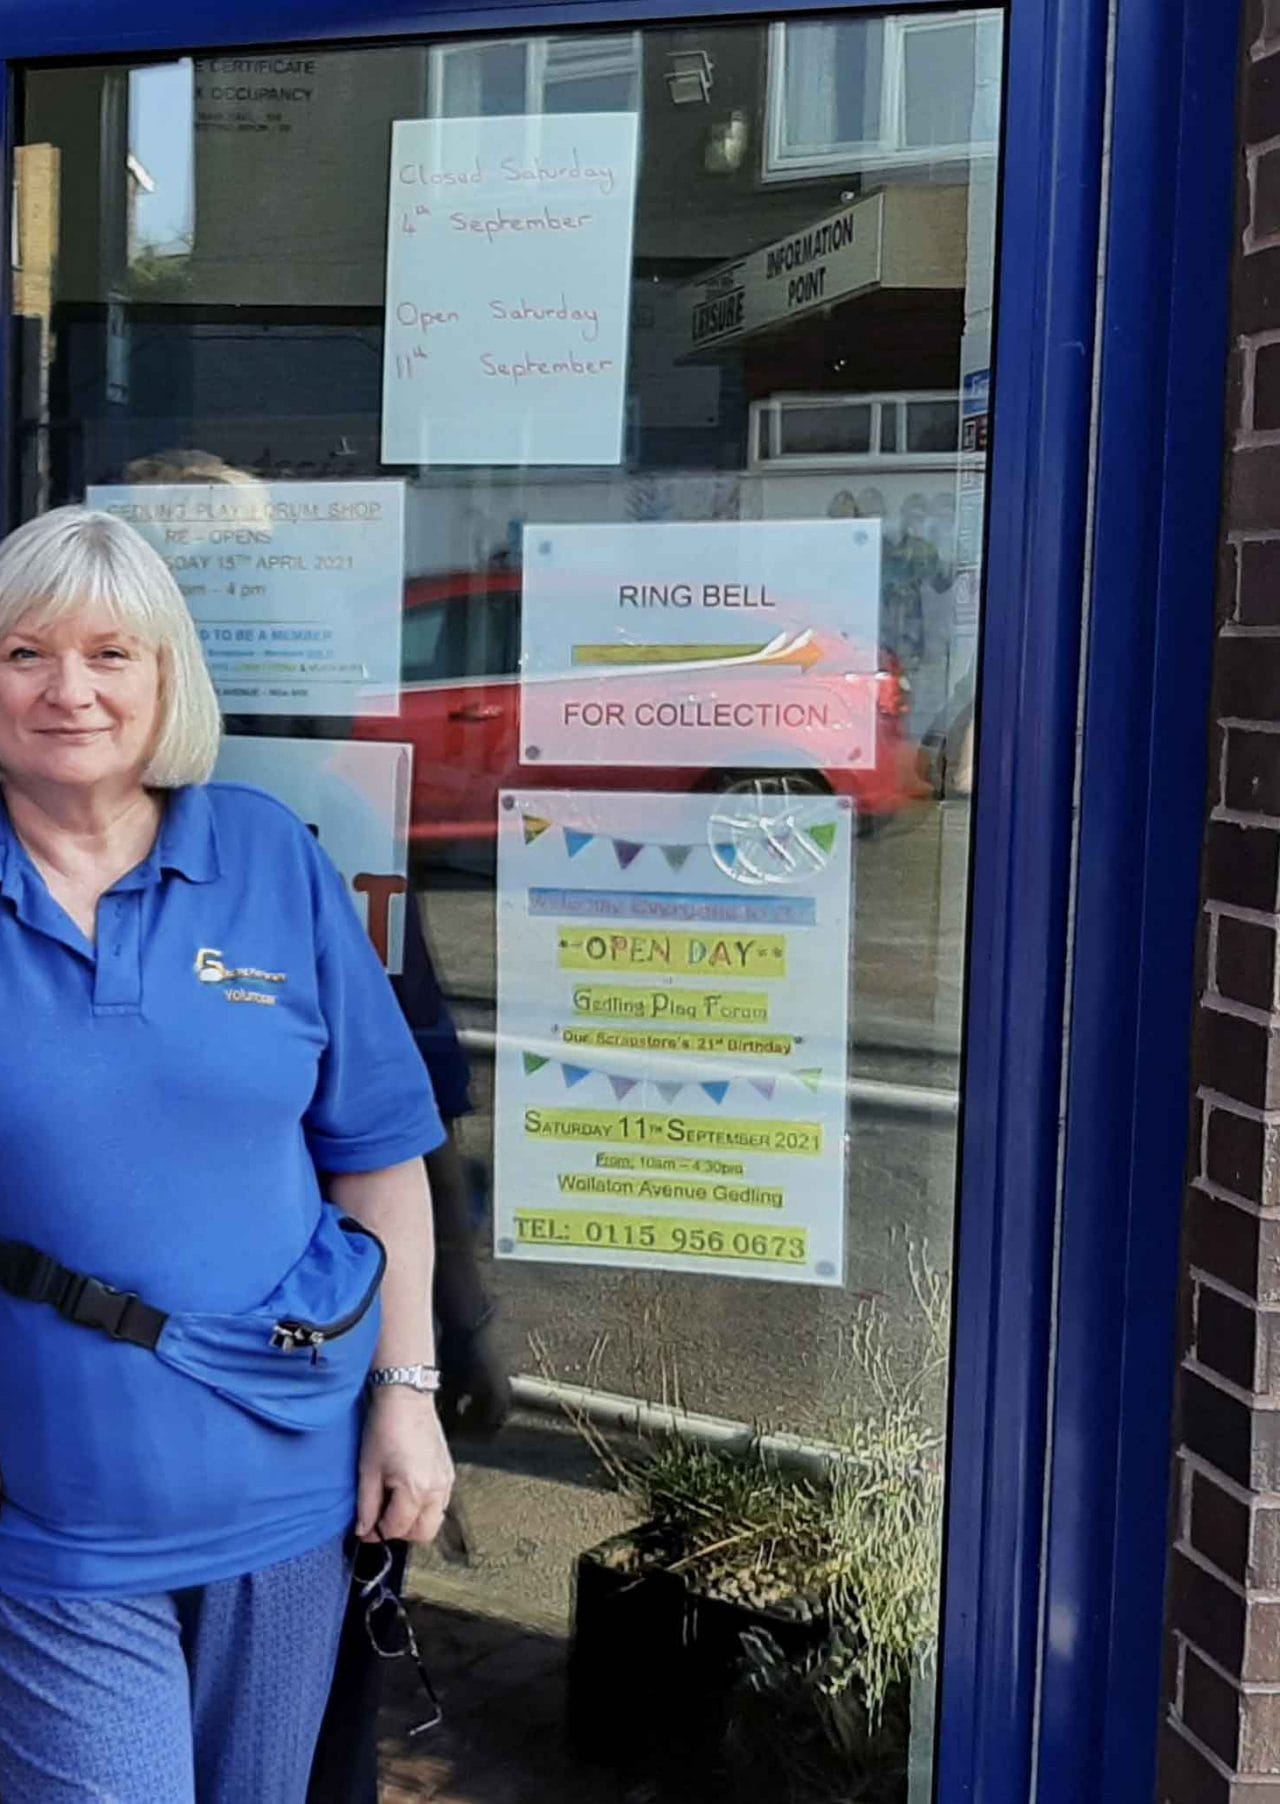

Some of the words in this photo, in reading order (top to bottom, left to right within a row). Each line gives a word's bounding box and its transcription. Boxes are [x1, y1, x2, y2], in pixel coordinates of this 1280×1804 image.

[210, 60, 316, 74] CERTIFICATE
[211, 86, 312, 101] OCCUPANCY
[399, 156, 481, 186] Closed
[497, 147, 615, 196] Saturday
[450, 205, 592, 243] September
[766, 213, 854, 281] INFORMATION
[787, 265, 827, 308] POINT
[396, 302, 459, 336] Open
[488, 292, 599, 342] Saturday
[479, 350, 613, 386] September
[195, 502, 239, 519] PLAY
[328, 501, 382, 520] SHOP
[208, 529, 272, 545] OPENS
[256, 555, 308, 571] APRIL
[619, 585, 691, 607] RING
[703, 585, 775, 608] BELL
[214, 629, 232, 641] TO
[563, 702, 624, 727] FOR
[635, 703, 828, 728] COLLECTION
[572, 988, 646, 1018] Gedling
[652, 992, 696, 1018] Play
[703, 995, 768, 1020] Forum
[562, 1029, 589, 1044] Our
[728, 1039, 792, 1056] Birthday
[524, 1110, 613, 1137] SATURDAY
[666, 1118, 770, 1146] SEPTEMBER
[774, 1132, 821, 1150] 2021
[640, 1156, 676, 1171] 10am
[638, 1181, 708, 1200] Avenue
[712, 1185, 784, 1209] Gedling
[513, 1217, 571, 1240] TEL:
[585, 1221, 656, 1247] 0115
[670, 1227, 724, 1251] 956
[731, 1233, 806, 1259] 0673
